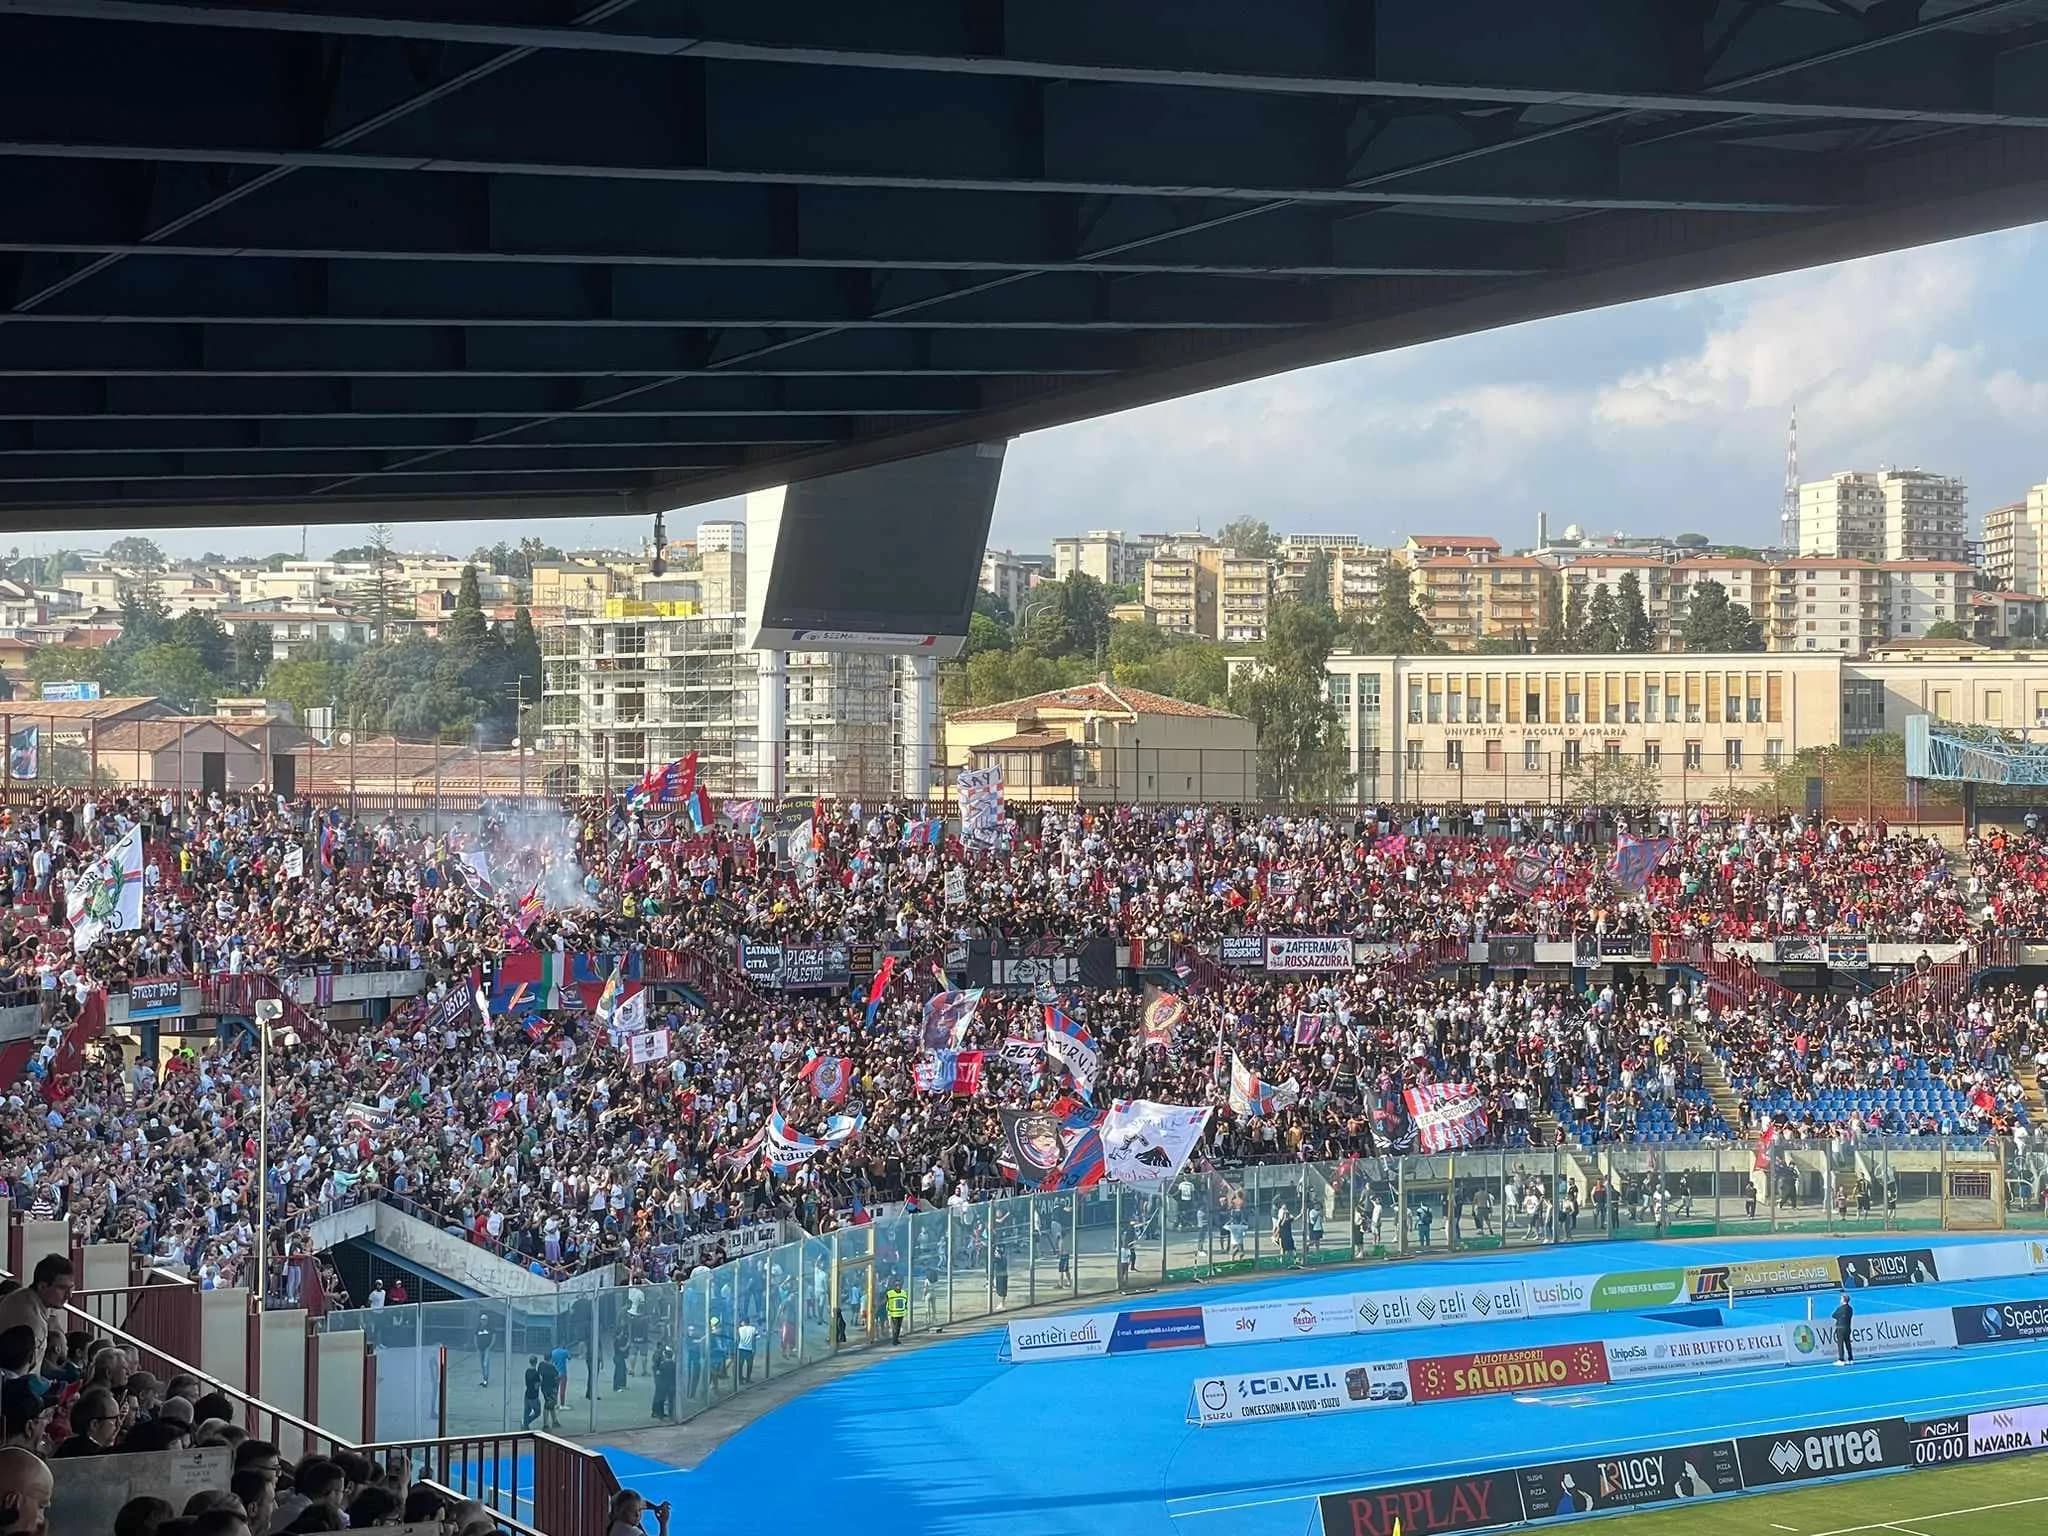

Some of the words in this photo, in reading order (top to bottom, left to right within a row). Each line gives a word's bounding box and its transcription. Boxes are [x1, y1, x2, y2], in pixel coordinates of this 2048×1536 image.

[1582, 727, 1627, 736] AGRARIA
[745, 945, 781, 955] CATANIA
[1223, 938, 1261, 948] GRAVINA
[1286, 941, 1338, 953] ZAFFERANA
[787, 950, 824, 966] PIAZZA
[1223, 948, 1261, 958] PRESENTE
[1285, 955, 1350, 967] ROSSAZZURRA
[787, 967, 824, 983] PALESTRO
[132, 984, 158, 999] STREET
[159, 982, 178, 997] BOYS
[445, 987, 466, 1016] 95125
[1868, 1255, 1909, 1278] TRILOGY
[1743, 1267, 1829, 1283] AUTORICAMBI
[1494, 1286, 1520, 1309] celi
[1533, 1280, 1584, 1304] tusibio
[1383, 1296, 1410, 1318] celi
[1440, 1290, 1466, 1314] celi
[1236, 1316, 1256, 1332] sky
[1293, 1313, 1318, 1326] Restart
[1018, 1326, 1067, 1346] cantieri
[1070, 1320, 1097, 1341] edili
[1876, 1320, 1924, 1341] Kluwer
[1610, 1346, 1647, 1361] UnipolSai
[1692, 1340, 1735, 1356] BUFFO
[1737, 1338, 1747, 1351] E
[1749, 1335, 1783, 1349] FIGLI
[1473, 1350, 1544, 1365] AUTOTRASPORTI
[1454, 1360, 1568, 1391] SALADINO
[1241, 1402, 1297, 1417] CONCESSIONARIA
[1297, 1400, 1317, 1411] VOLVO
[1320, 1397, 1341, 1409] ISUZU
[1203, 1411, 1233, 1421] ISUZU
[1916, 1438, 1963, 1464] 00:00
[1974, 1432, 2032, 1454] NAVARRA
[1716, 1463, 1732, 1471] PIZZA
[1598, 1456, 1665, 1497] TRILOGY
[1530, 1488, 1546, 1496] PIZZA
[1348, 1479, 1493, 1536] REPLAY
[1532, 1502, 1549, 1511] DRINK
